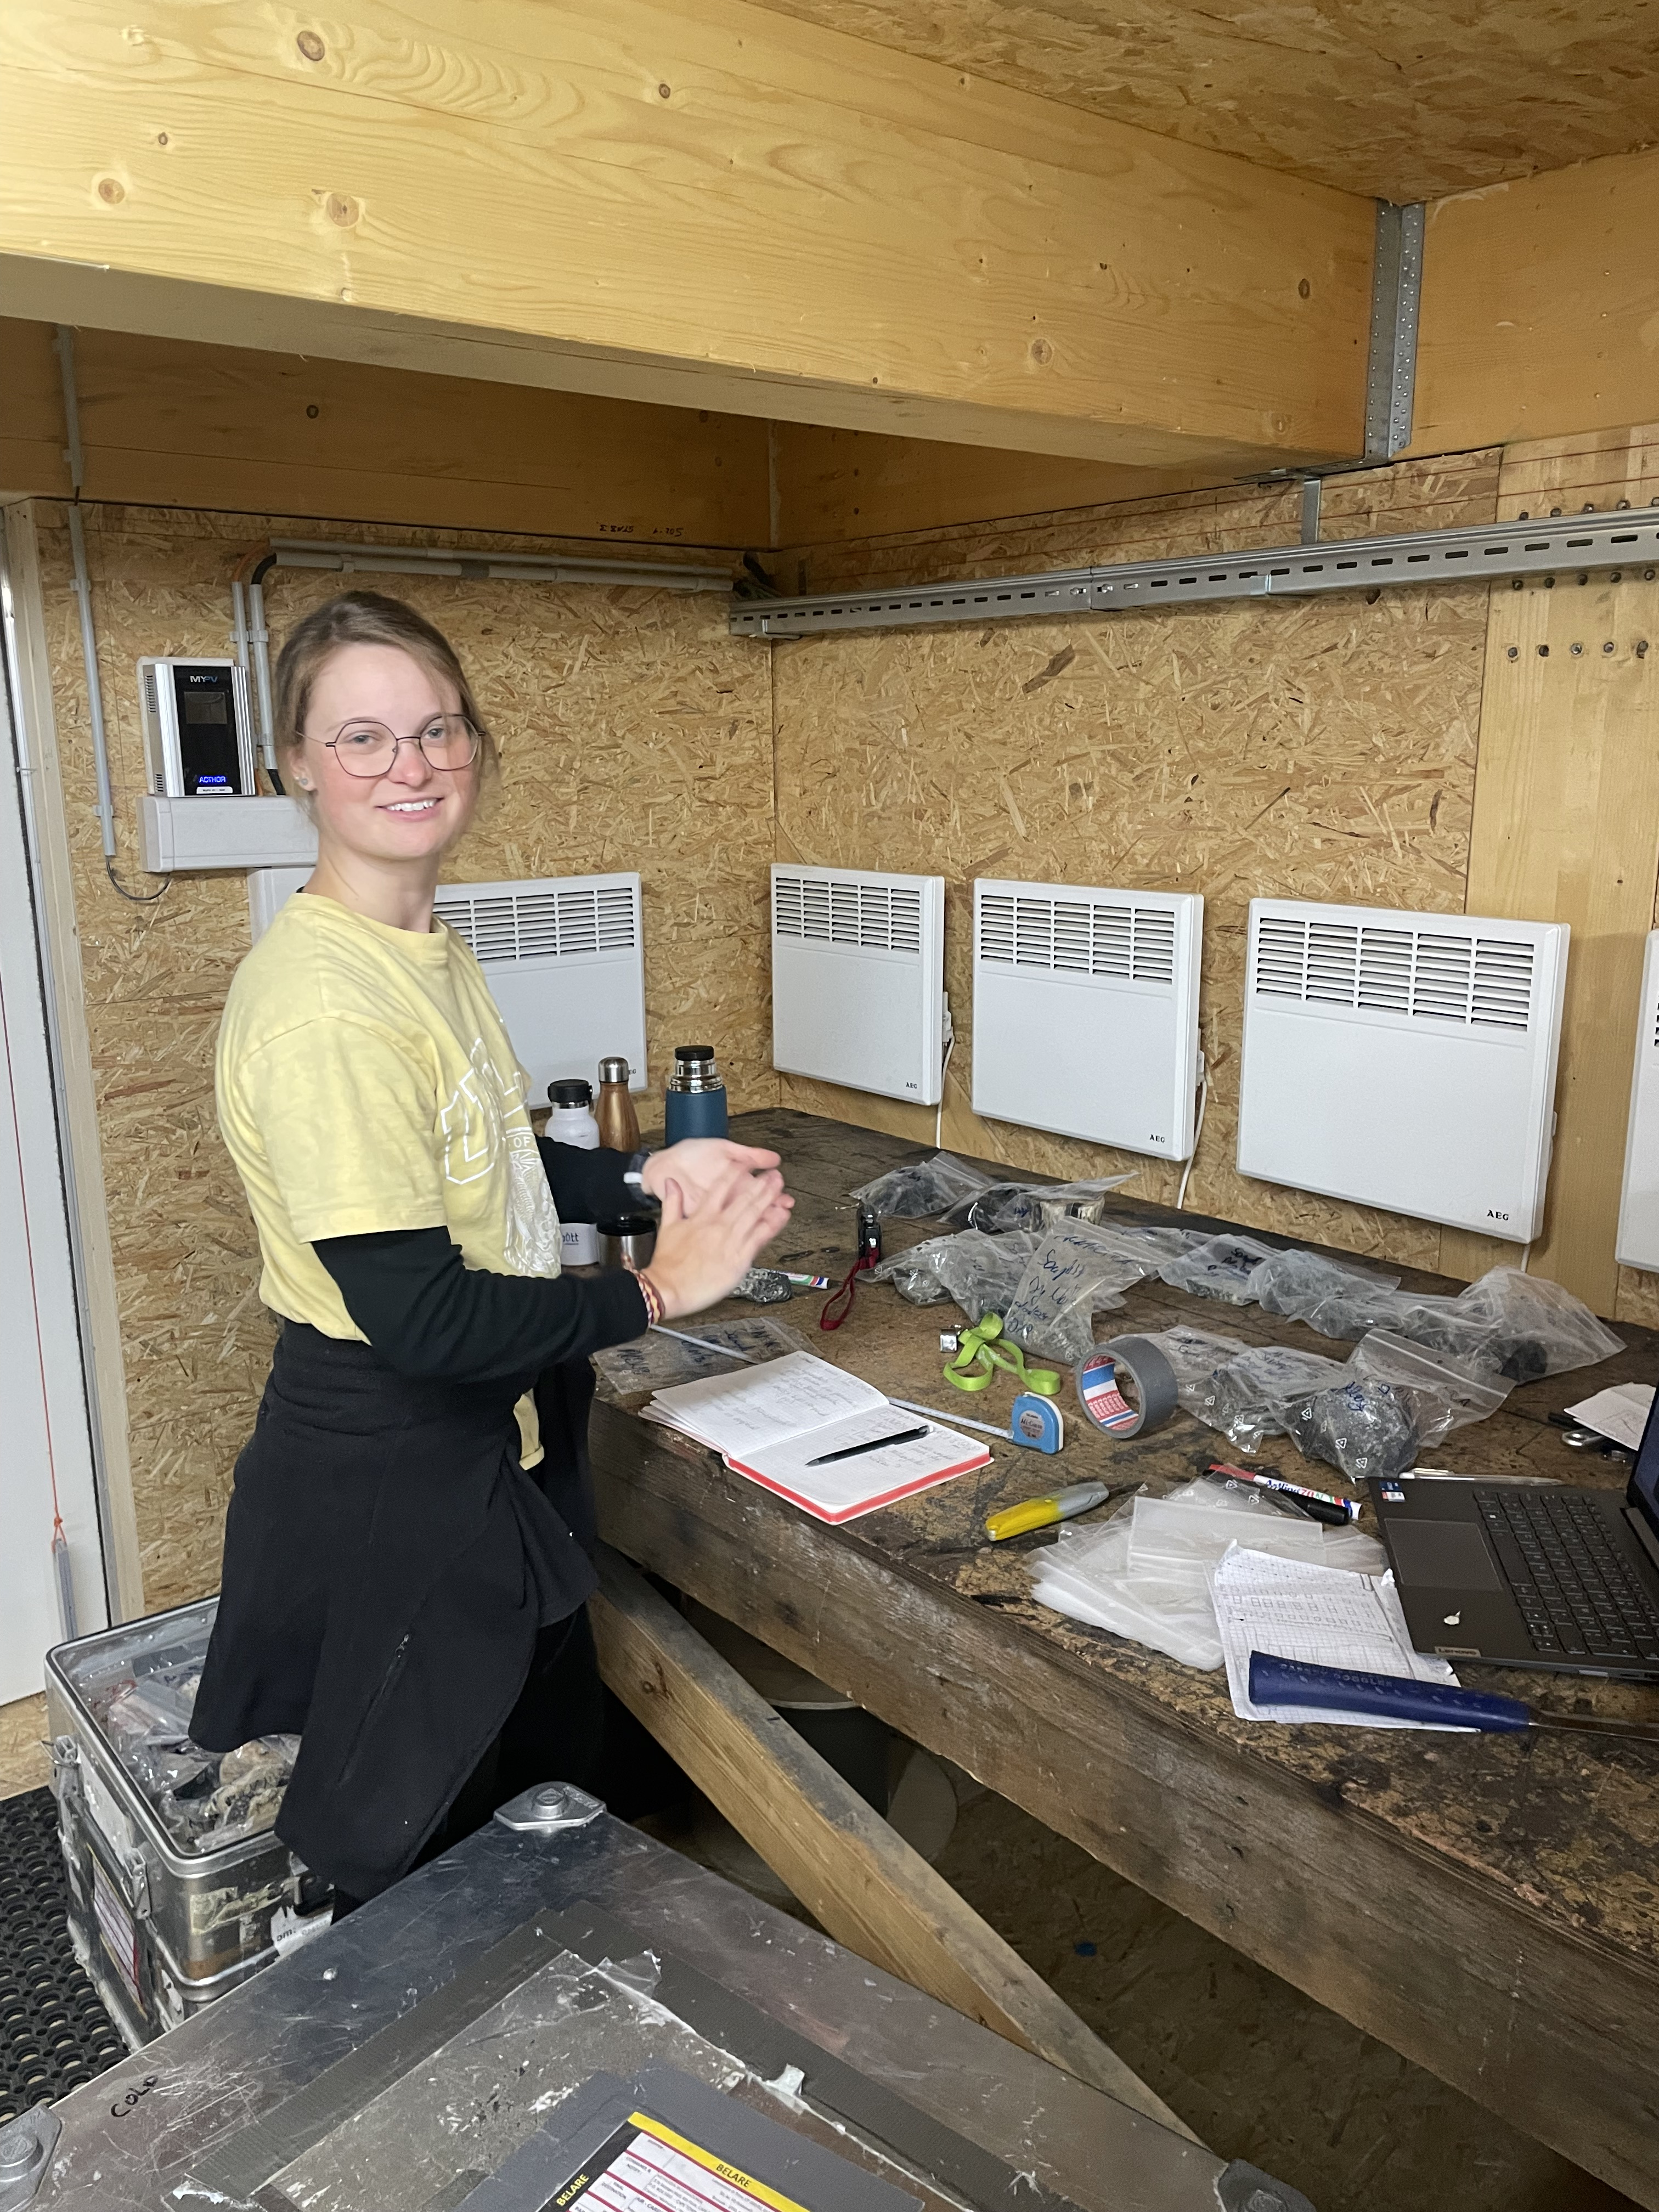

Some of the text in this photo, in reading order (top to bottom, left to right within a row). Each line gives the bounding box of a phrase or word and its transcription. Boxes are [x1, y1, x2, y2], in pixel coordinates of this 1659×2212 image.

[514, 1136, 531, 1148] OF
[1149, 1134, 1165, 1143] AEG
[1487, 1209, 1509, 1221] AEG
[110, 2075, 158, 2118] COLD
[716, 2164, 752, 2188] BELARE
[556, 2174, 589, 2205] BELARE
